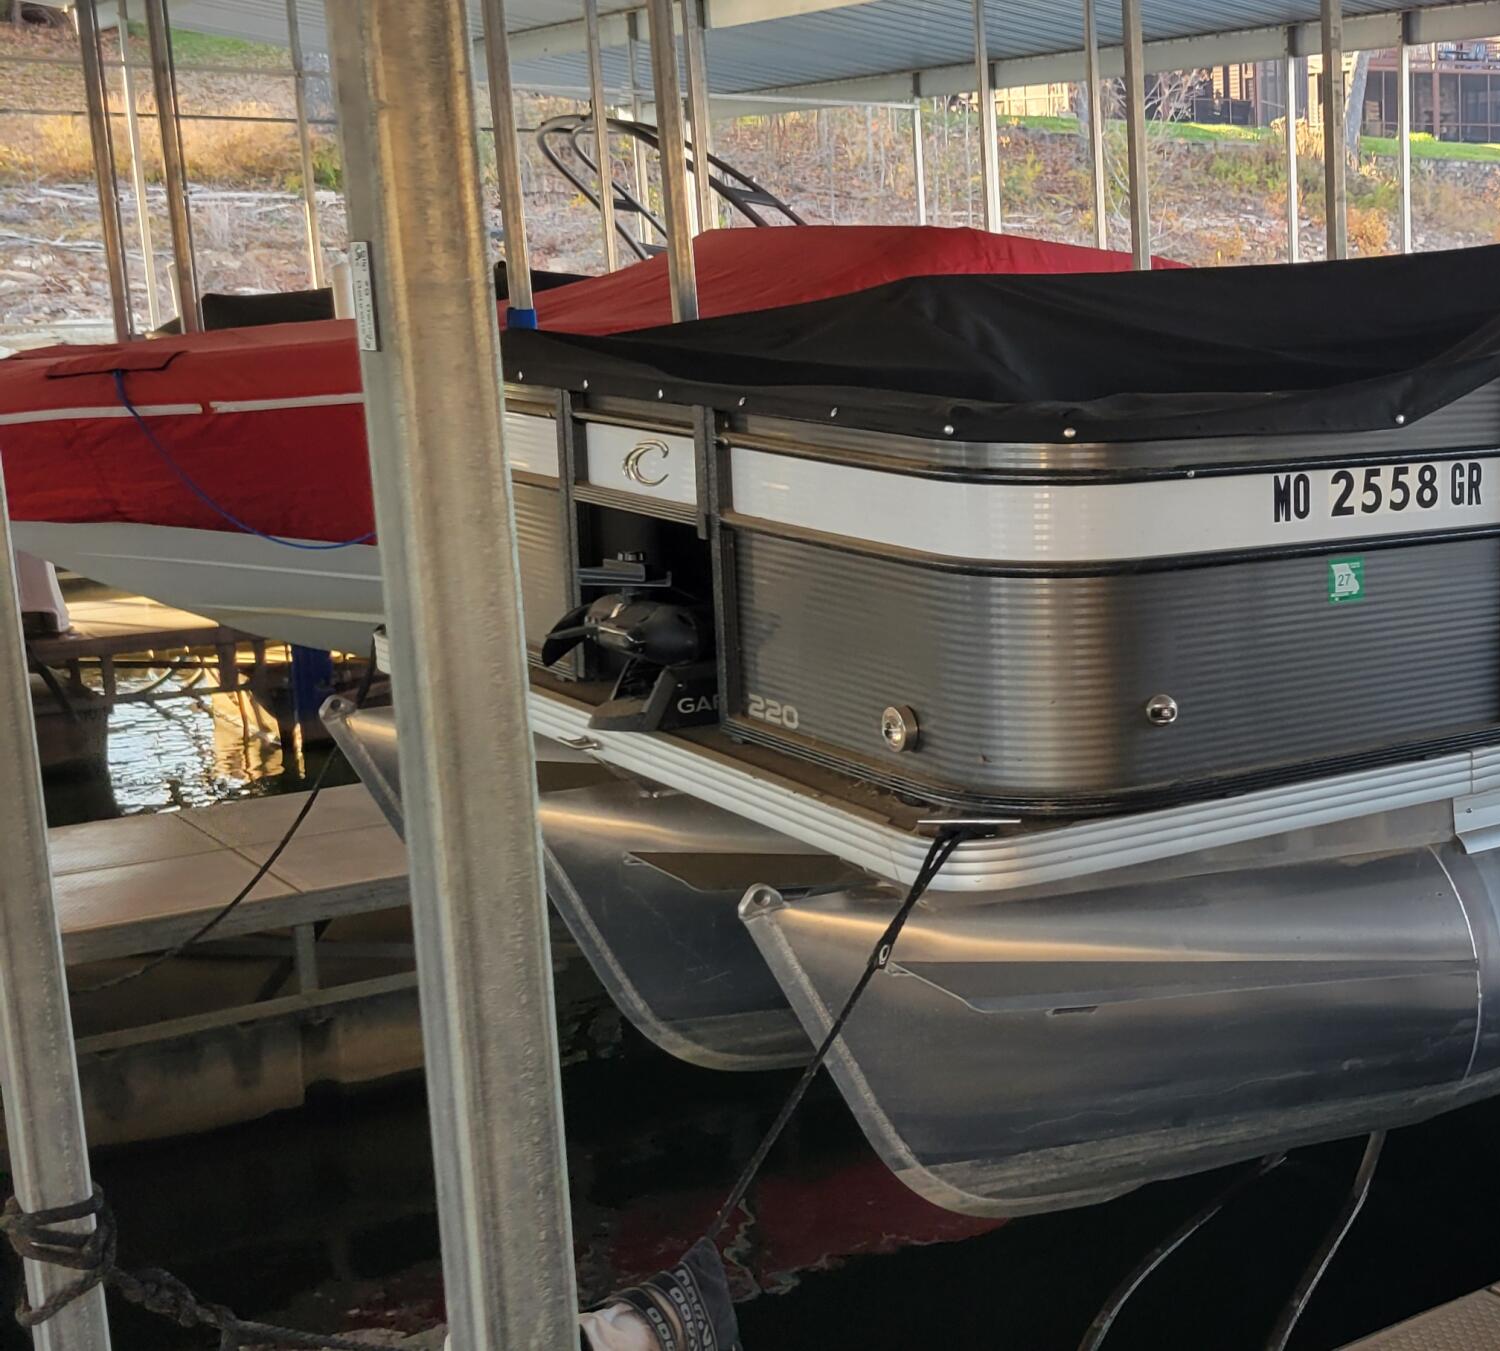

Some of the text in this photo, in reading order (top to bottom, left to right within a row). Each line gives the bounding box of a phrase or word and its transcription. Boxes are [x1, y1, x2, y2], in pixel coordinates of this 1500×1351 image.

[1273, 462, 1482, 523] MO 2558 GR
[1337, 573, 1351, 587] 27
[748, 694, 800, 729] 220
